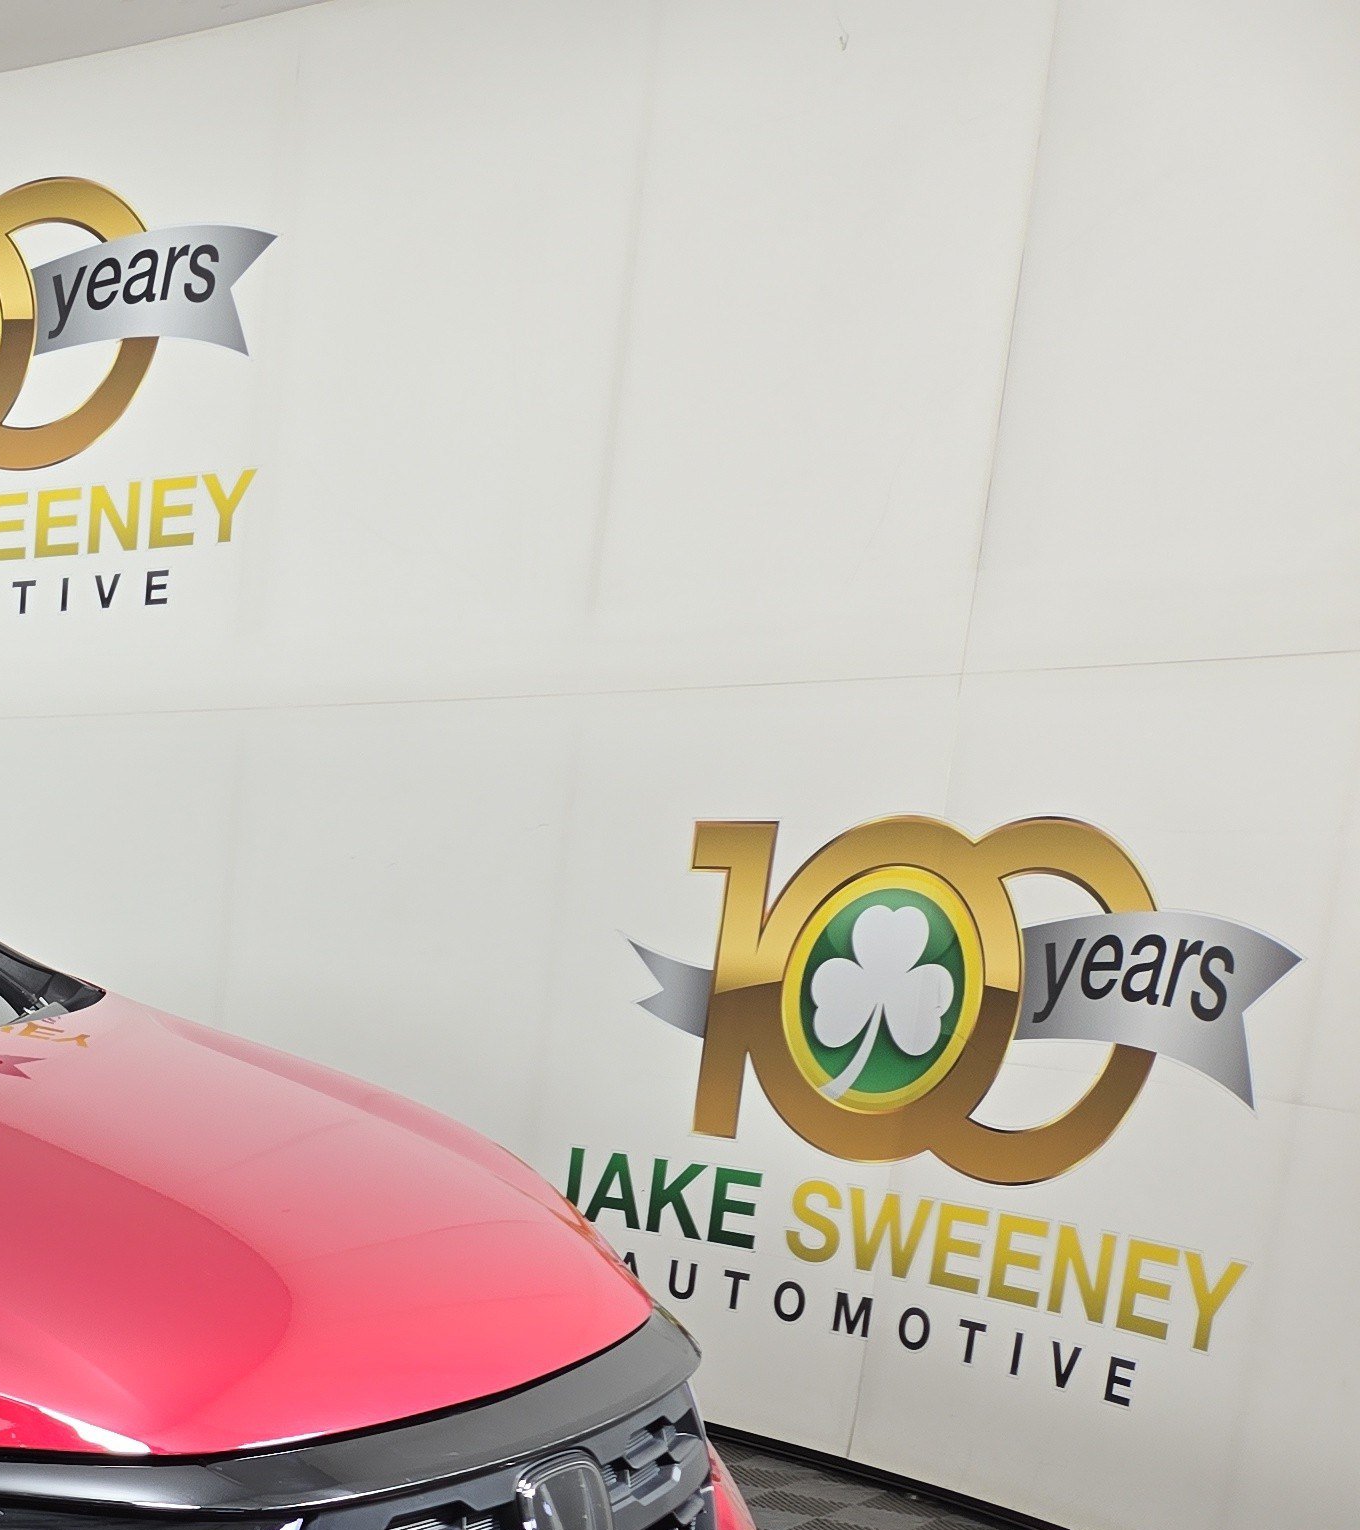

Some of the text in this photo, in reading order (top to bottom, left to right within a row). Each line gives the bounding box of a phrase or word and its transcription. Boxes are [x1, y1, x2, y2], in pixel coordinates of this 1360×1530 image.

[48, 242, 220, 339] years
[1031, 933, 1235, 1024] years
[784, 1179, 1248, 1353] SWEENEY
